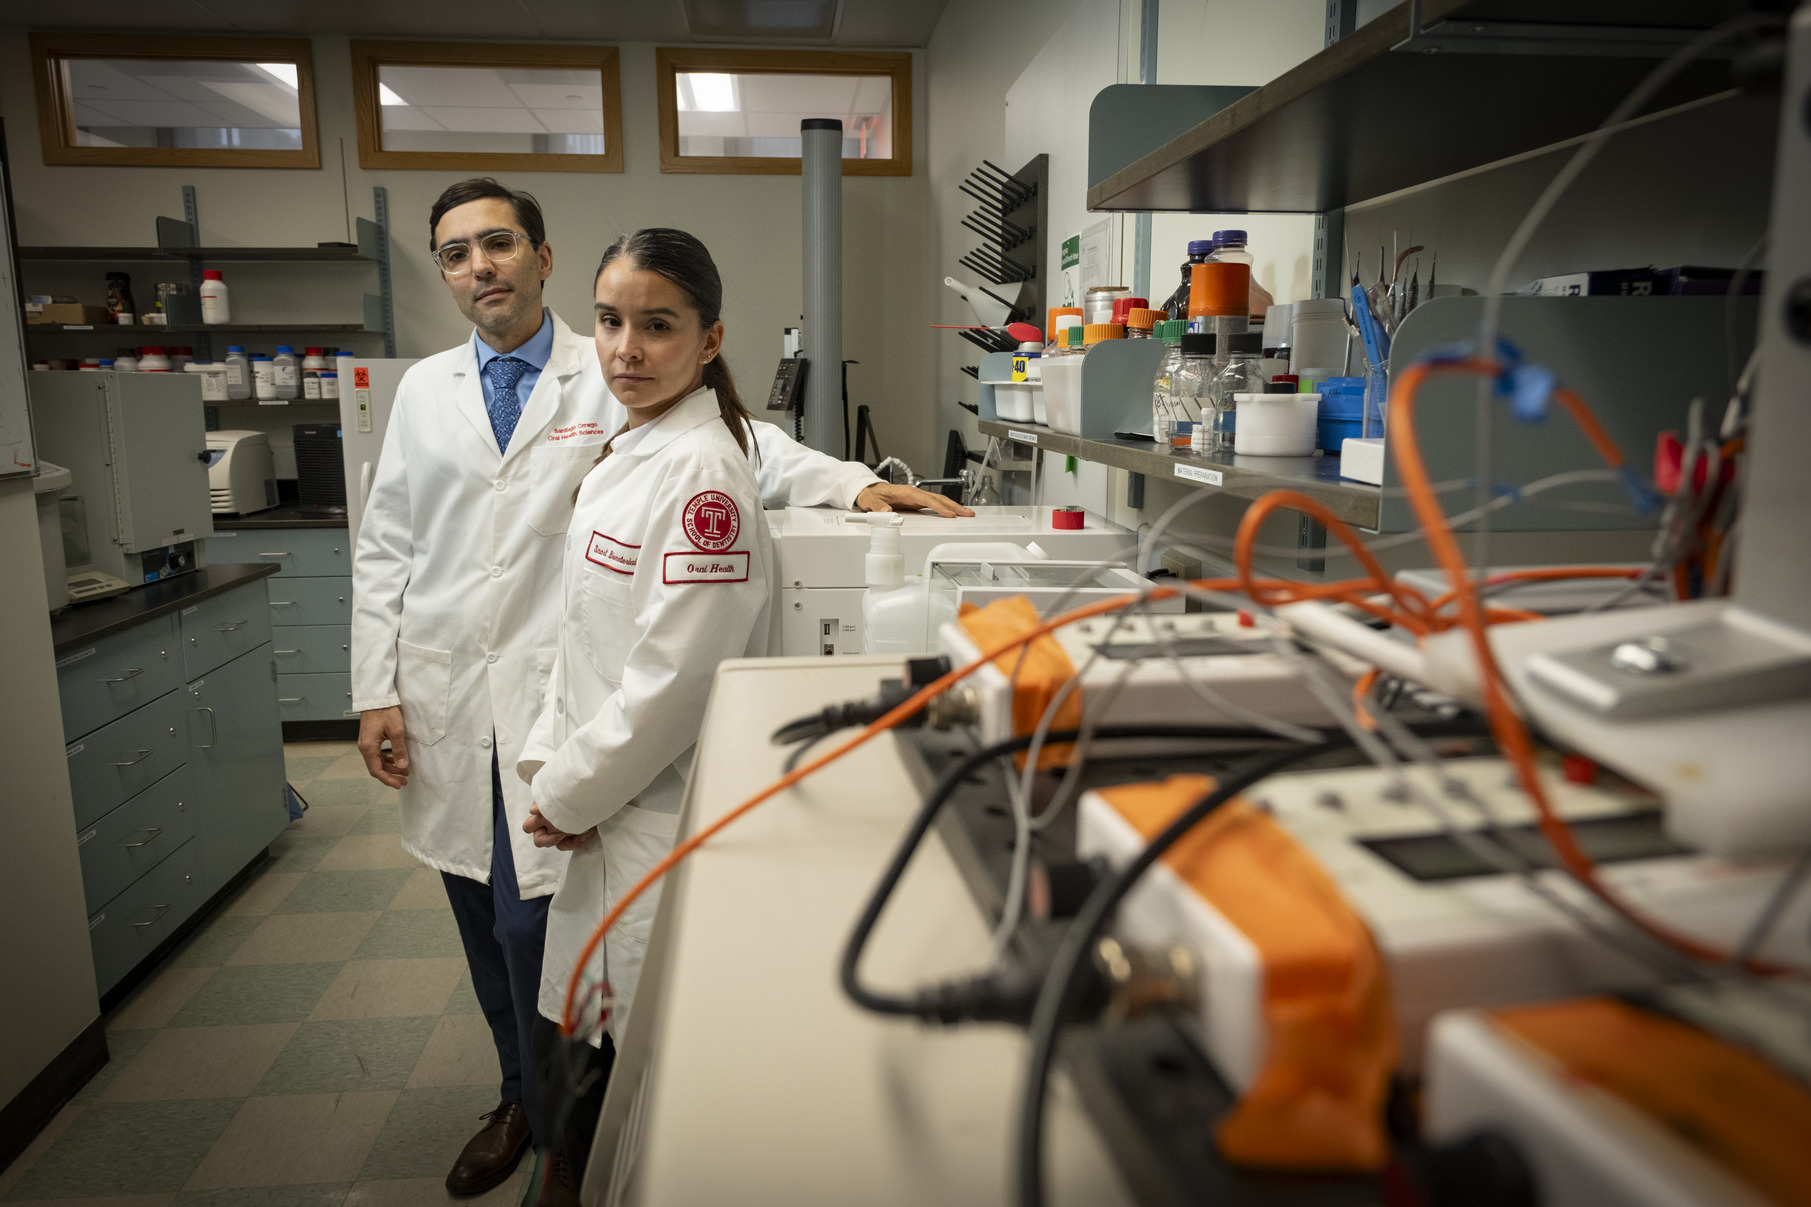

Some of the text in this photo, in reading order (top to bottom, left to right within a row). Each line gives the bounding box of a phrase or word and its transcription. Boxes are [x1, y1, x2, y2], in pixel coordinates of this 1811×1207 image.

[553, 425, 577, 434] Santiago
[561, 431, 578, 440] Health
[687, 493, 737, 523] TEMPLE UNIVERSITY
[686, 517, 737, 549] SCHOOL OF DENTISTRY
[687, 563, 735, 574] Oral Health
